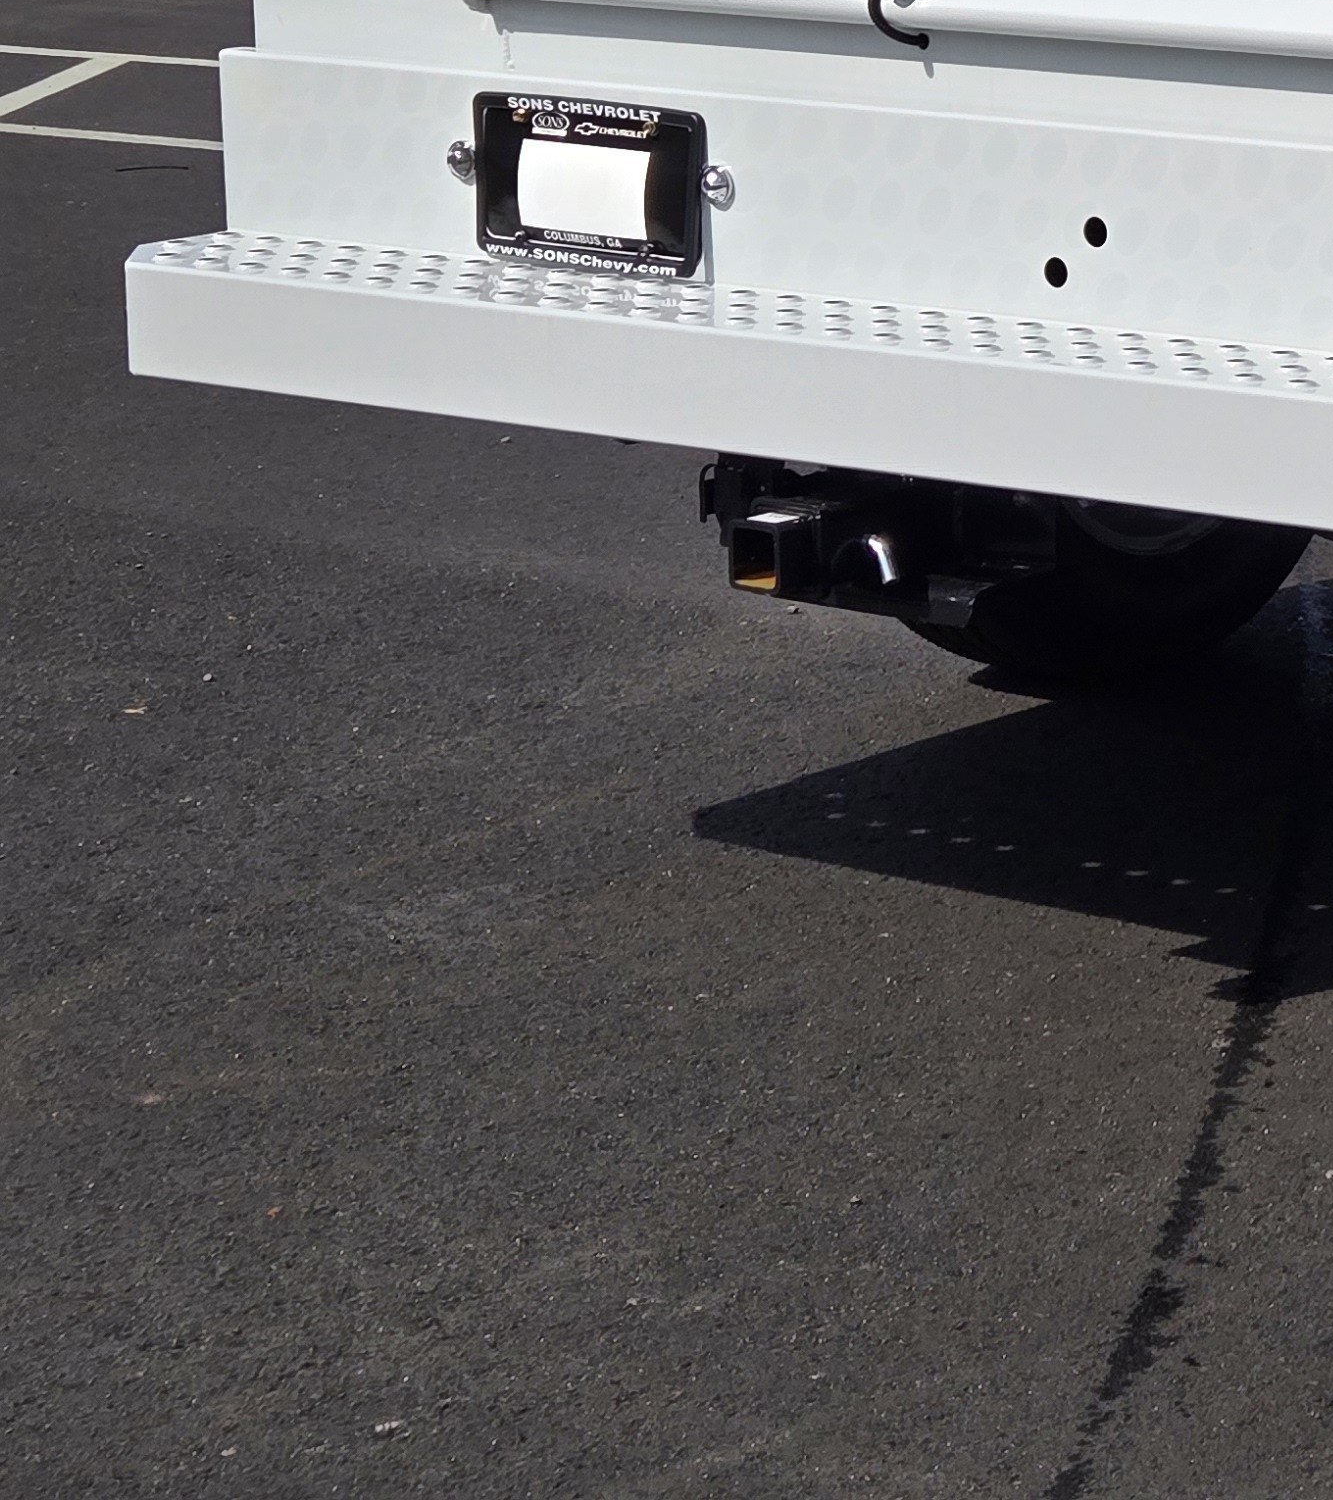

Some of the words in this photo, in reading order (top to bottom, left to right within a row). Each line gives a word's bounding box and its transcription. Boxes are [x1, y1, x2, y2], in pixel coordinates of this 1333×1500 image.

[507, 96, 554, 112] SONS
[558, 100, 661, 123] CHEVROLET
[537, 115, 564, 129] SONS
[599, 127, 649, 139] CHEVROLET
[543, 230, 605, 248] COLUMBUS,
[606, 237, 622, 249] GA
[486, 244, 677, 277] www.SONSChevy.com
